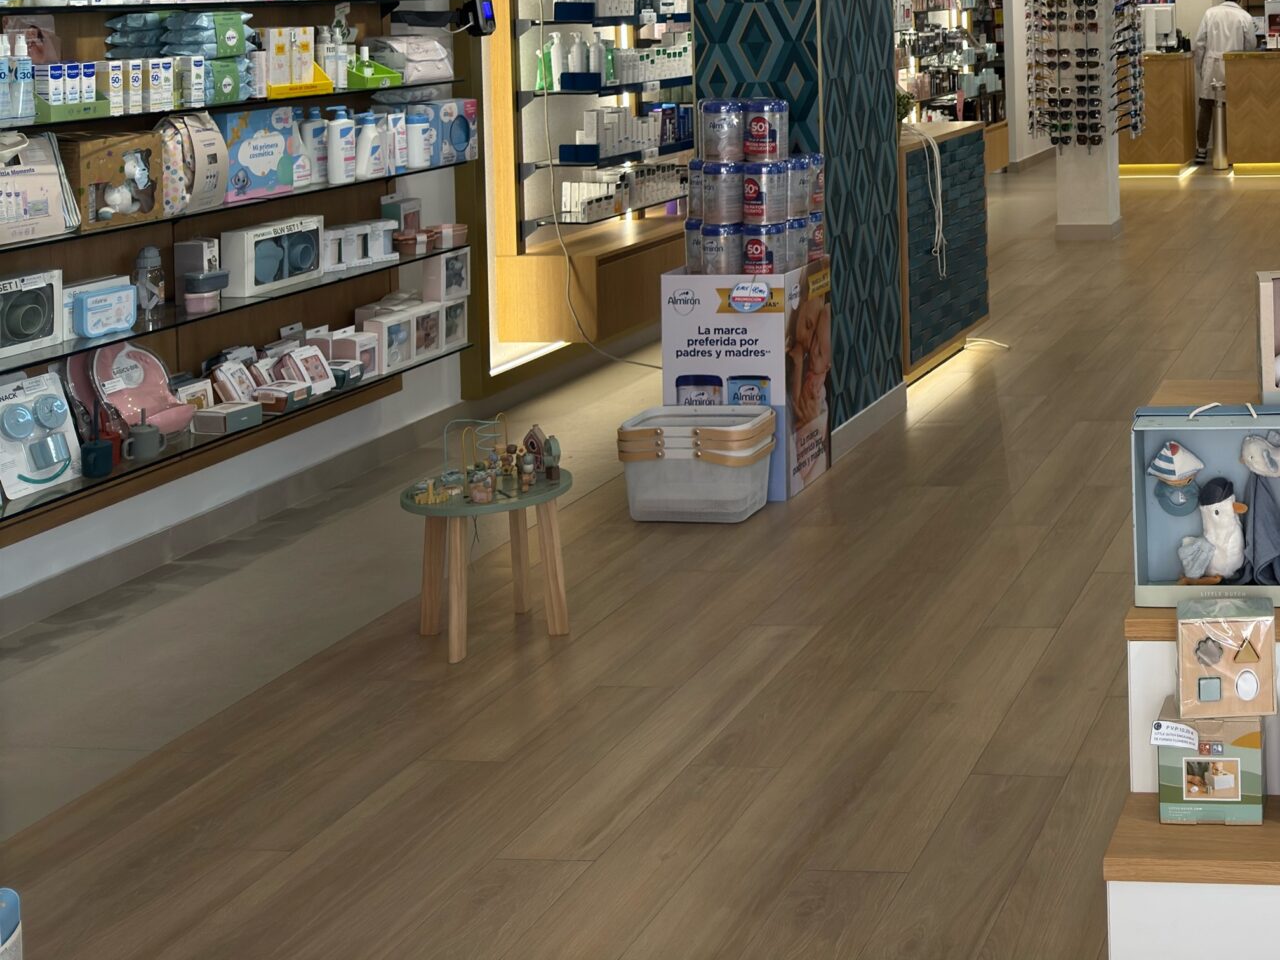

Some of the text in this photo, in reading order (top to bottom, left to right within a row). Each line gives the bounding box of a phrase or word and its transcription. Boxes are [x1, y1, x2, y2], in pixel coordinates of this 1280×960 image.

[19, 71, 31, 80] 30
[252, 141, 279, 152] Mi primera
[249, 149, 274, 160] cosmética
[272, 226, 285, 236] BLW
[286, 223, 296, 232] SET
[668, 296, 700, 305] Almirón
[698, 326, 748, 335] La marca
[687, 336, 759, 347] preferida por
[676, 347, 712, 358] padres
[715, 350, 722, 359] y
[0, 392, 18, 403] NACK
[684, 397, 715, 405] Almirón
[733, 392, 766, 401] Almirón
